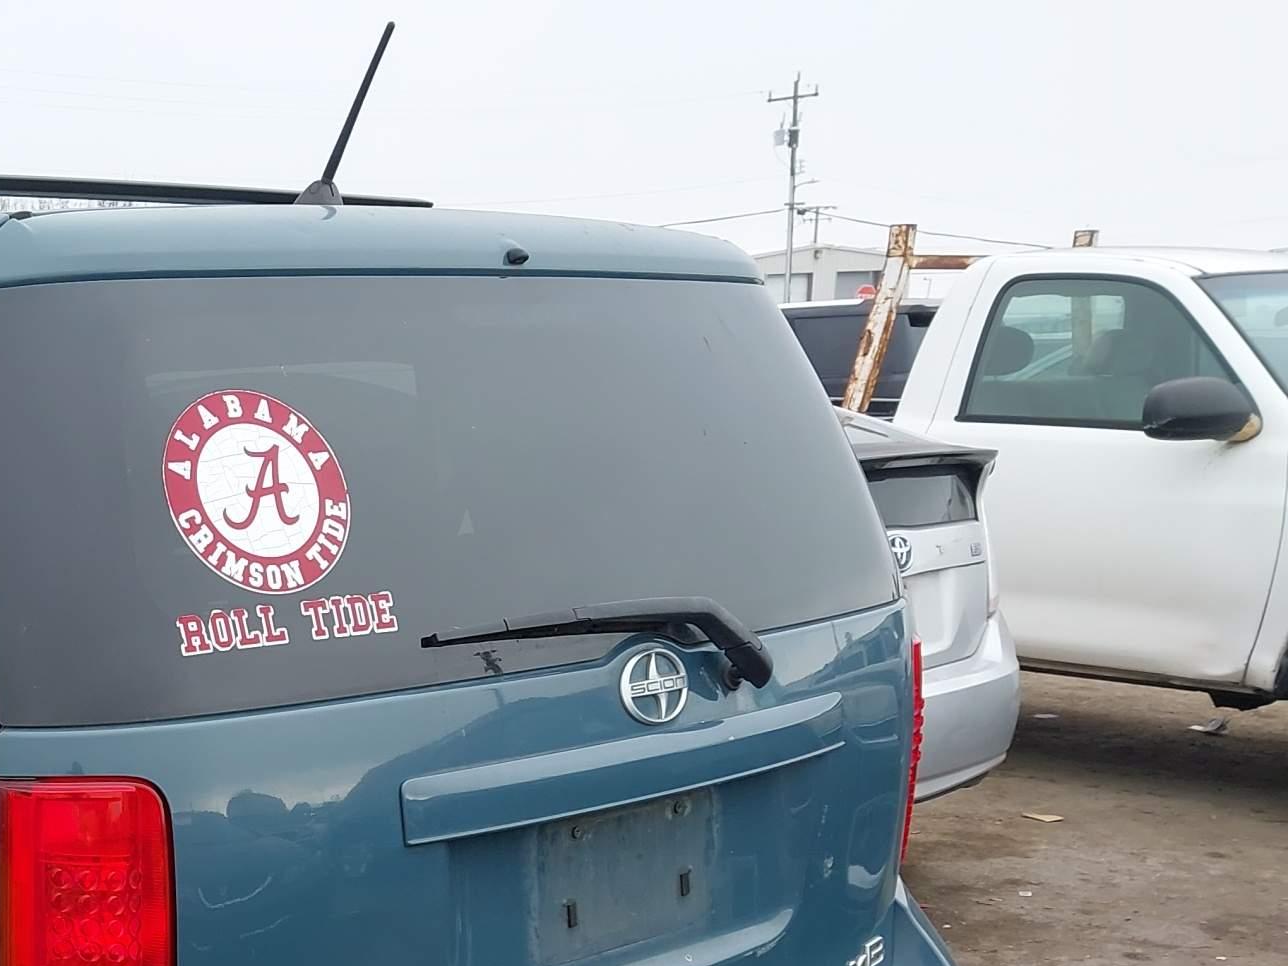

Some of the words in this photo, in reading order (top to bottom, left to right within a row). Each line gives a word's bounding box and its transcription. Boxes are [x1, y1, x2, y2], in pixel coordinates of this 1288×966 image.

[166, 394, 331, 480] ALABAMA
[222, 443, 301, 530] A
[177, 508, 305, 590] CRIMSON
[305, 498, 348, 571] TIDE
[176, 604, 289, 657] ROLL
[301, 591, 399, 641] TIDE
[630, 674, 686, 696] SCION
